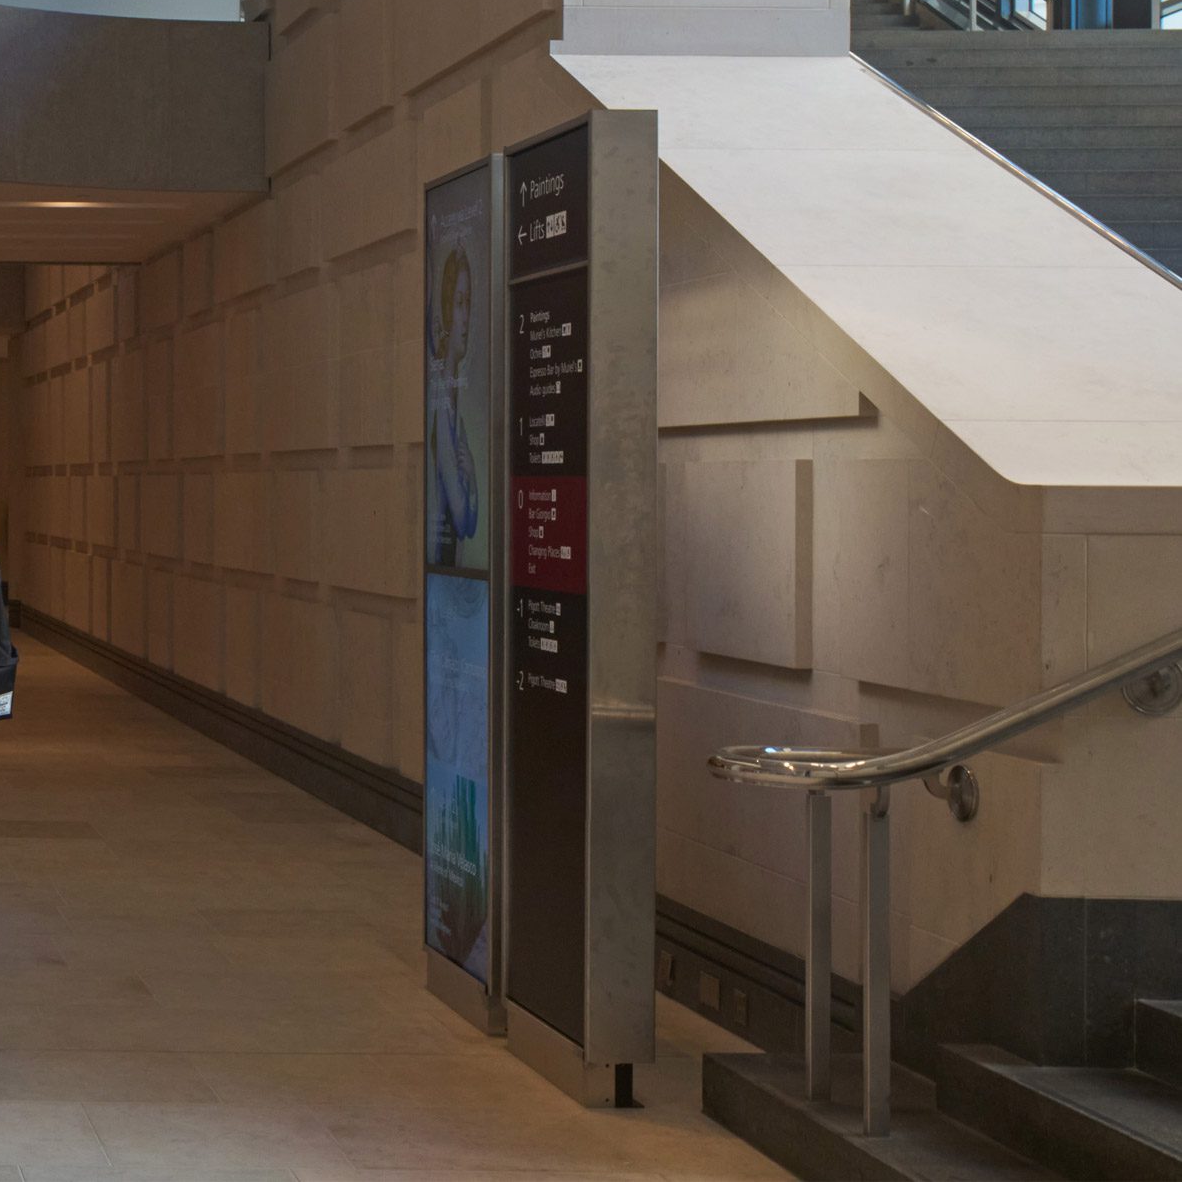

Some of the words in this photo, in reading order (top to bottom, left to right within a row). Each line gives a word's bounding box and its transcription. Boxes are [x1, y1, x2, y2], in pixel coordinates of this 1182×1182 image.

[530, 173, 565, 199] Paintings
[529, 221, 545, 243] Lifts
[519, 314, 525, 334] 2
[530, 310, 550, 323] Paintings
[519, 417, 523, 436] 1
[518, 489, 524, 509] 0
[528, 562, 536, 574] Exit
